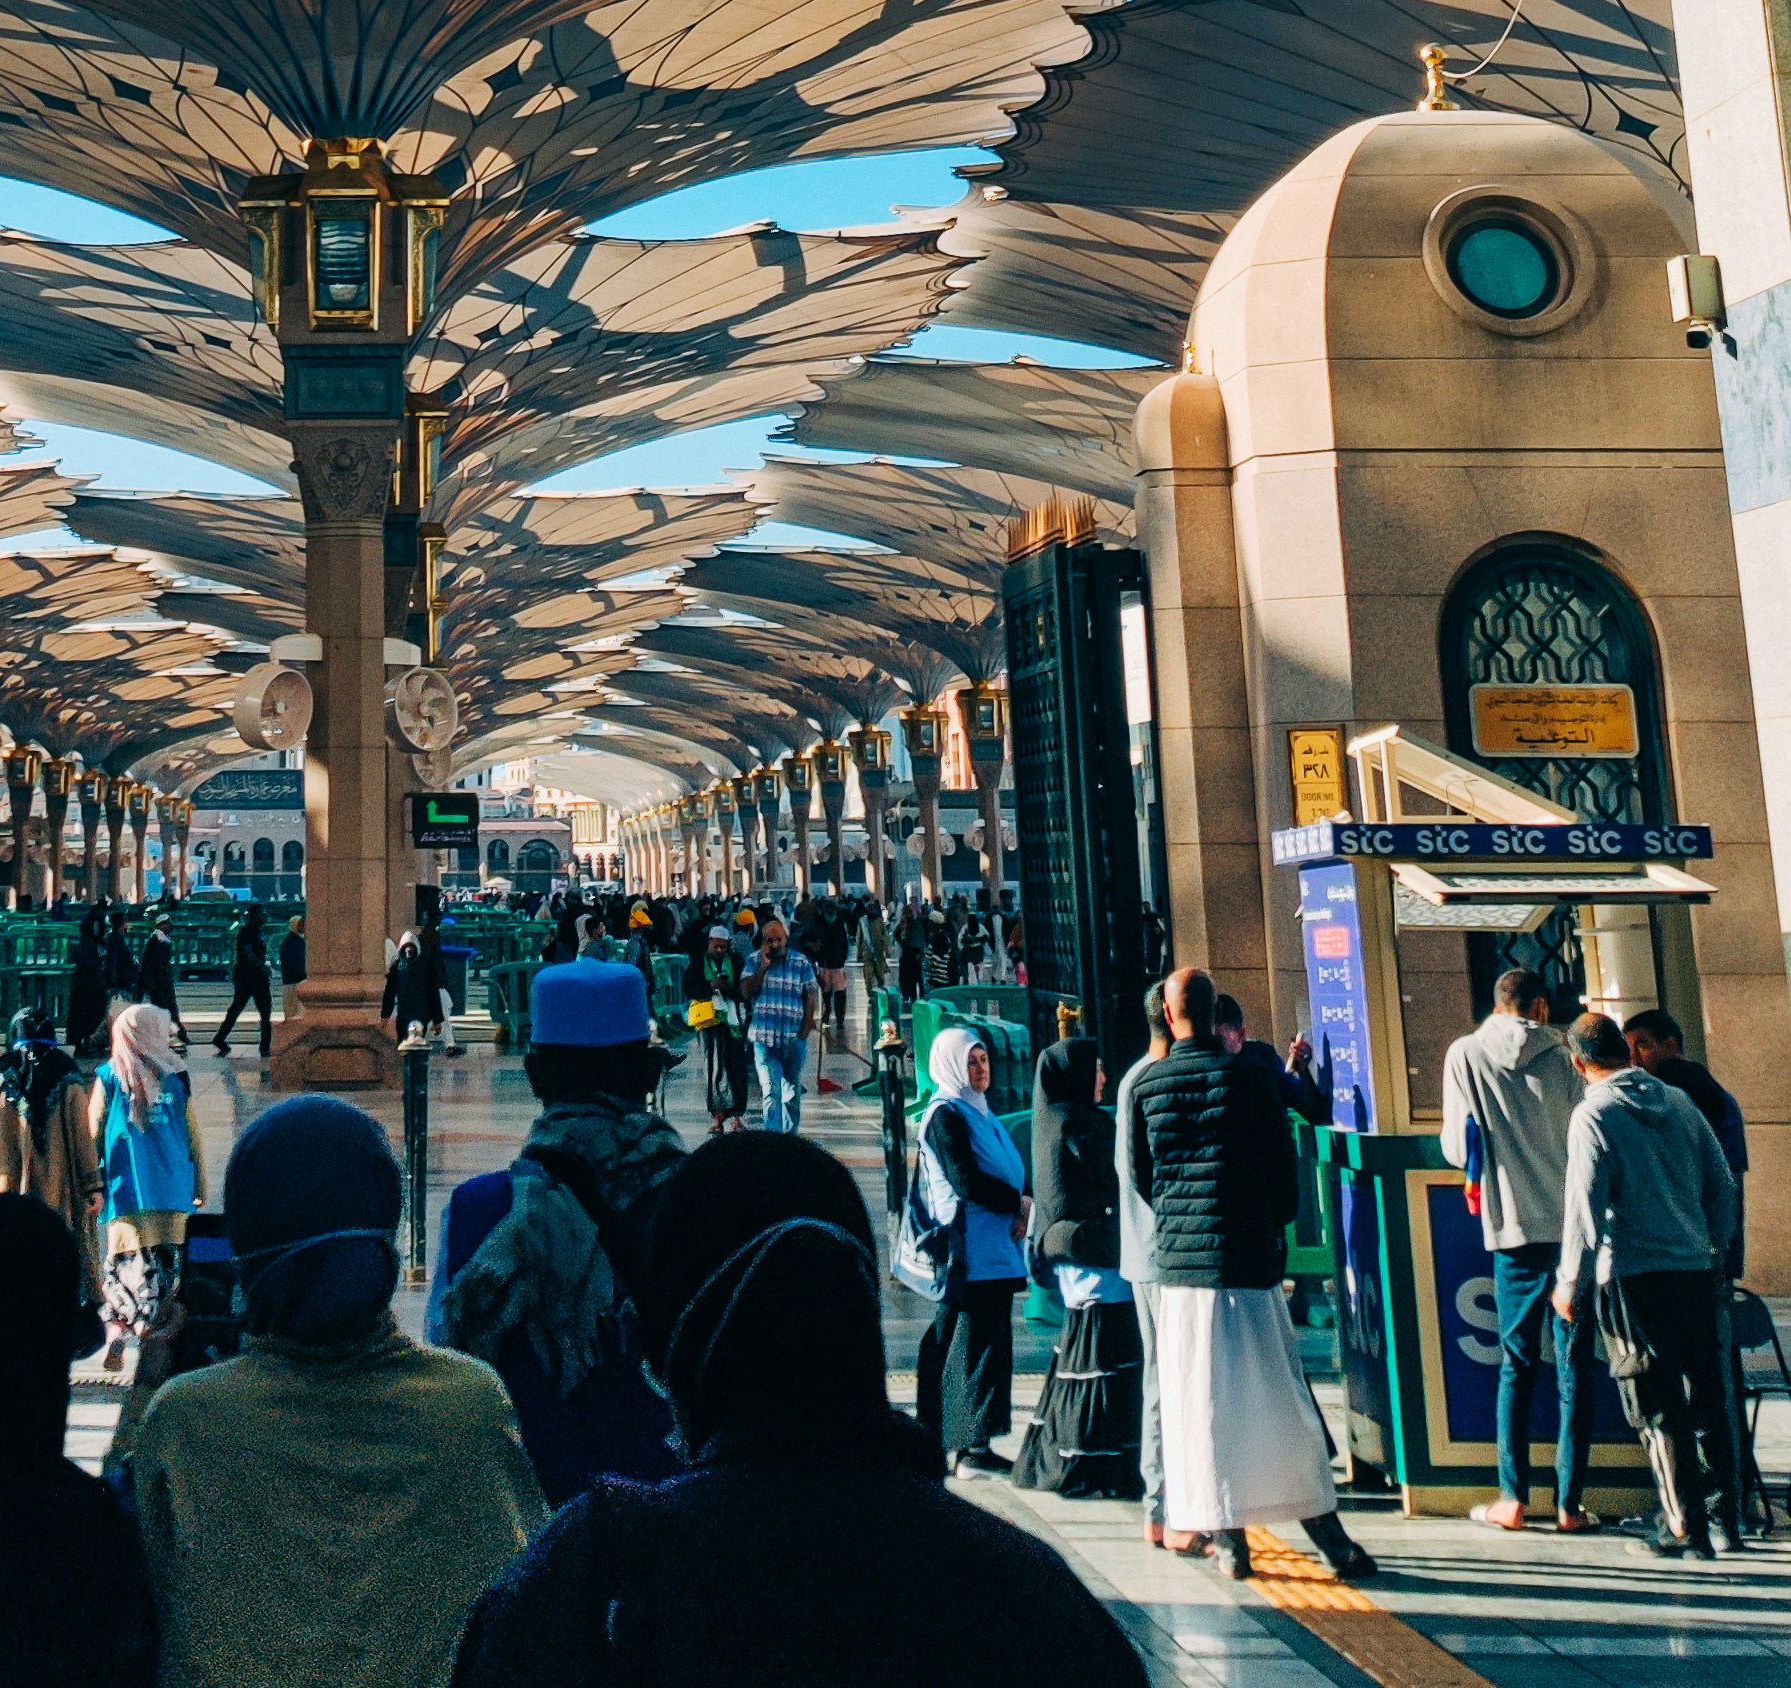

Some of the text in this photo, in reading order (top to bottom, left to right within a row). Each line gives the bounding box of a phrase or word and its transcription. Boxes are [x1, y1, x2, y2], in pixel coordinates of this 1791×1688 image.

[1340, 825, 1395, 854] stc
[1416, 825, 1471, 854] stc
[1491, 825, 1546, 854] stc
[1567, 825, 1622, 855] stc
[1643, 825, 1698, 855] stc
